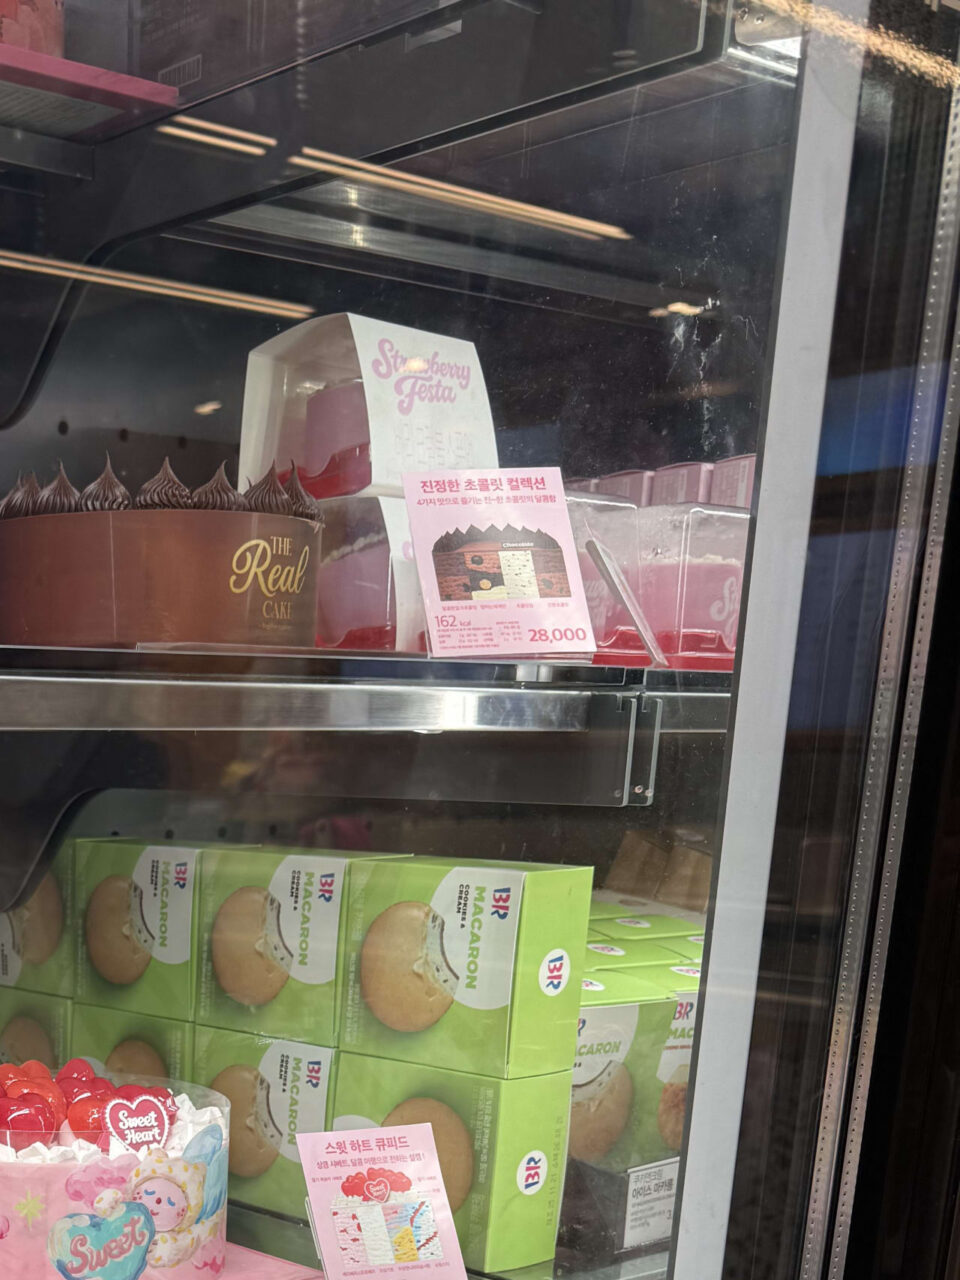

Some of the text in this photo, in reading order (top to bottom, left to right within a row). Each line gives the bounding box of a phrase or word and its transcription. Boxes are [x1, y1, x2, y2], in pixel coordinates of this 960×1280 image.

[394, 375, 457, 416] Festa
[420, 476, 547, 494] 진정한 초콜릿 컬렉션
[270, 536, 293, 556] THE
[229, 539, 309, 597] Real
[434, 615, 457, 628] 162
[528, 627, 587, 644] 28,000
[173, 862, 188, 890] BR
[318, 872, 335, 903] BR
[159, 860, 171, 947] MACARON
[298, 871, 315, 966] MACARON
[491, 887, 511, 920] BR
[465, 886, 486, 989] MACARON
[546, 955, 564, 989] BR
[305, 1061, 322, 1088] BR
[287, 1057, 302, 1145] MACARON
[118, 1110, 157, 1130] Sweet
[124, 1125, 162, 1145] Heart
[325, 1136, 410, 1155] 스윗 하트 큐피드
[524, 1156, 542, 1190] BR
[67, 1216, 147, 1275] Sweet
